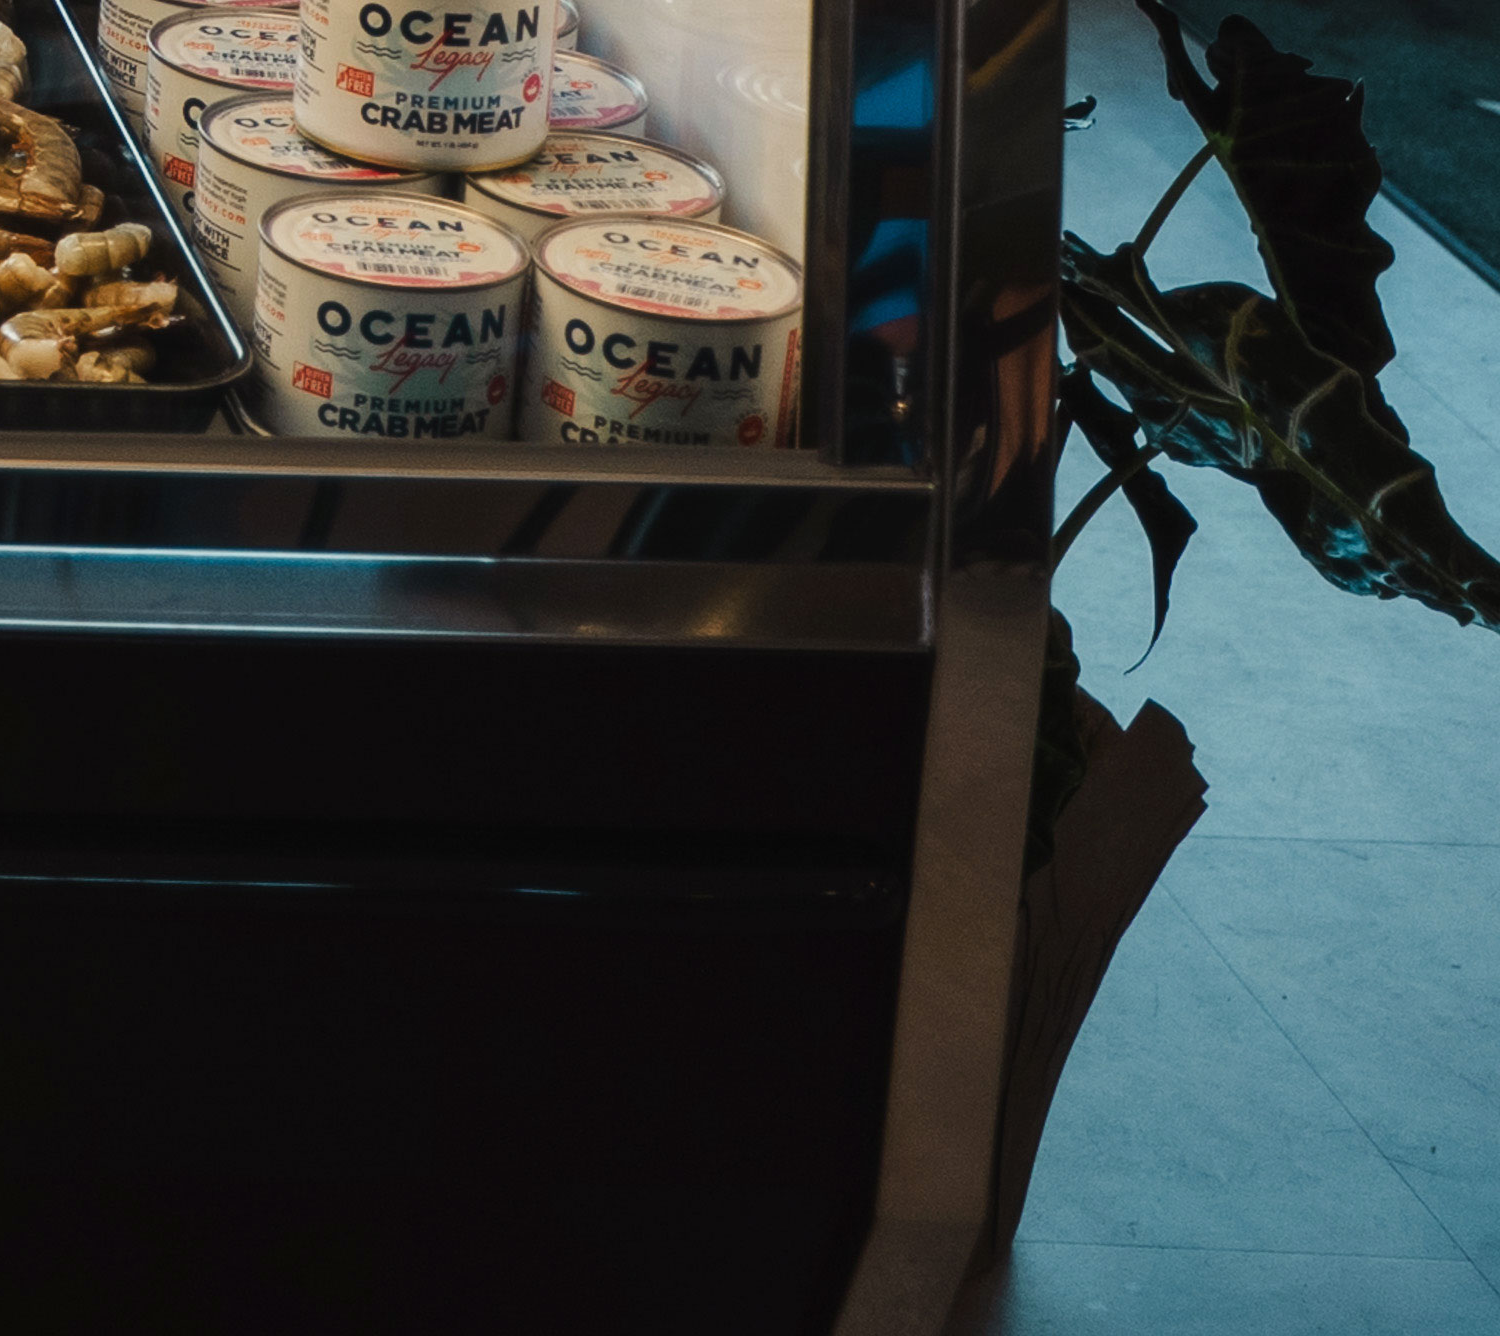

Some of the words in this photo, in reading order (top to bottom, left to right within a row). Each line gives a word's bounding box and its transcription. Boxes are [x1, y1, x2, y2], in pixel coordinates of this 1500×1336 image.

[358, 2, 541, 48] OCEAN
[409, 30, 495, 92] Legacy
[347, 78, 373, 98] FREE
[395, 91, 503, 112] PREMIUM
[360, 101, 448, 136] CRAB
[452, 105, 527, 136] MEAT
[311, 211, 465, 233] OCEAN
[602, 231, 761, 270] OCEAN
[317, 300, 507, 350] OCEAN
[369, 333, 460, 395] Legacy
[564, 318, 763, 382] OCEAN
[303, 376, 333, 399] FREE
[354, 393, 466, 414] PREMIUM
[609, 354, 703, 420] Legacy
[318, 403, 410, 438] CRAB
[413, 408, 491, 439] MEAT
[594, 414, 712, 446] PREMIUM
